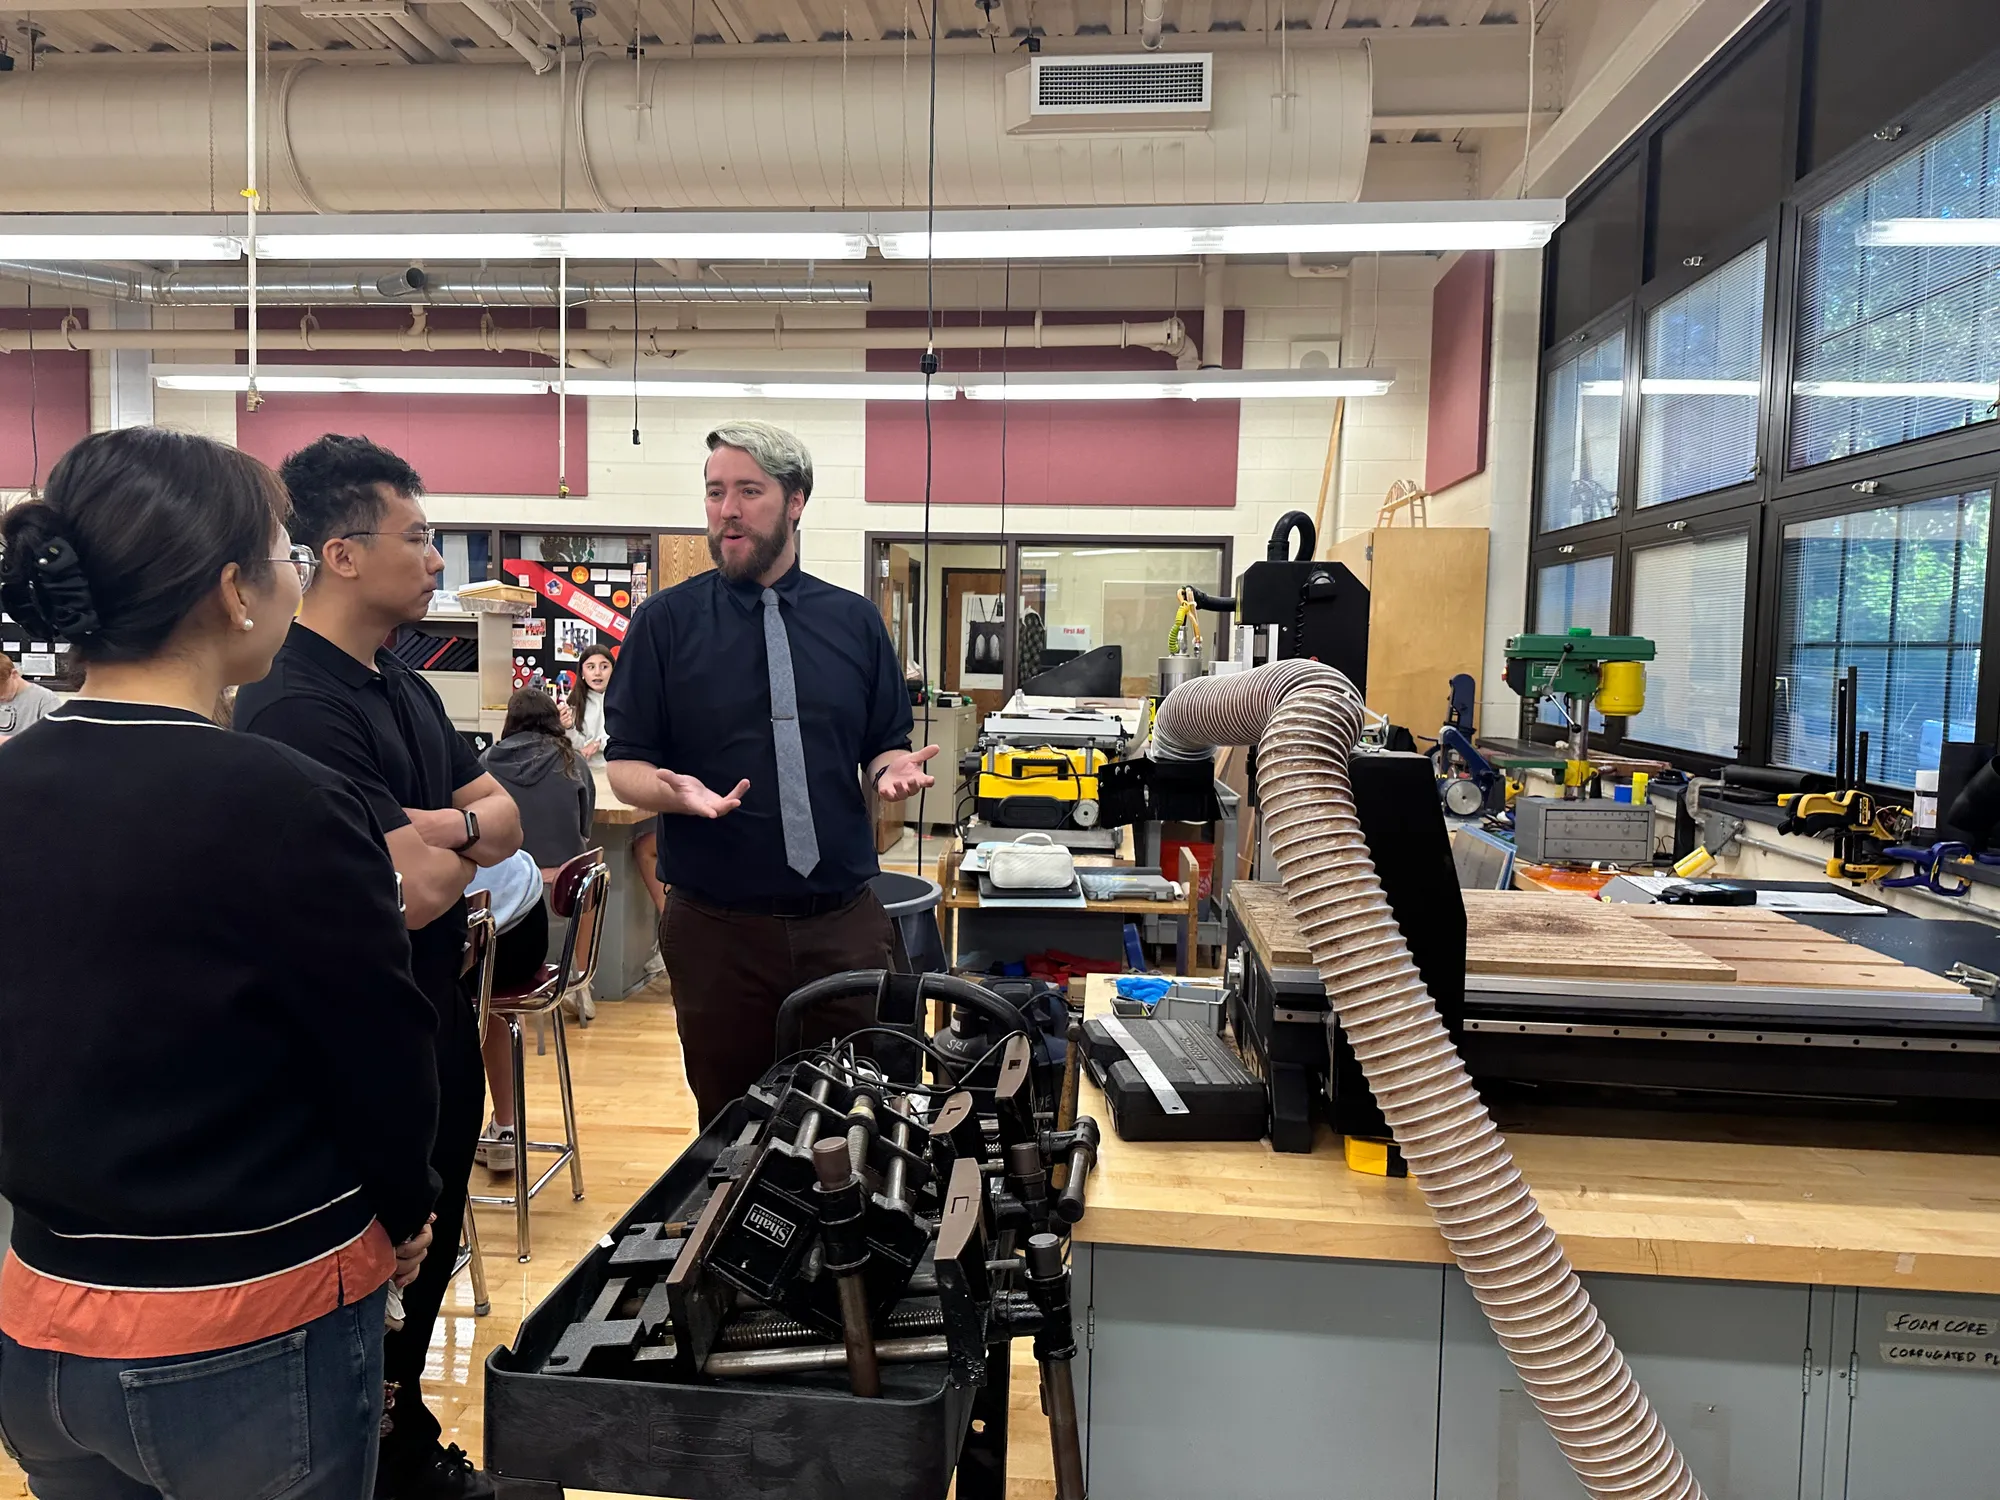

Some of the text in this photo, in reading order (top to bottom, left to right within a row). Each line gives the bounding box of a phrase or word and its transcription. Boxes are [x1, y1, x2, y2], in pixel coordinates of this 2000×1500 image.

[750, 1211, 789, 1241] Shain
[1894, 1313, 1988, 1336] FOAM CORE
[1889, 1347, 1977, 1362] CORRUGATED
